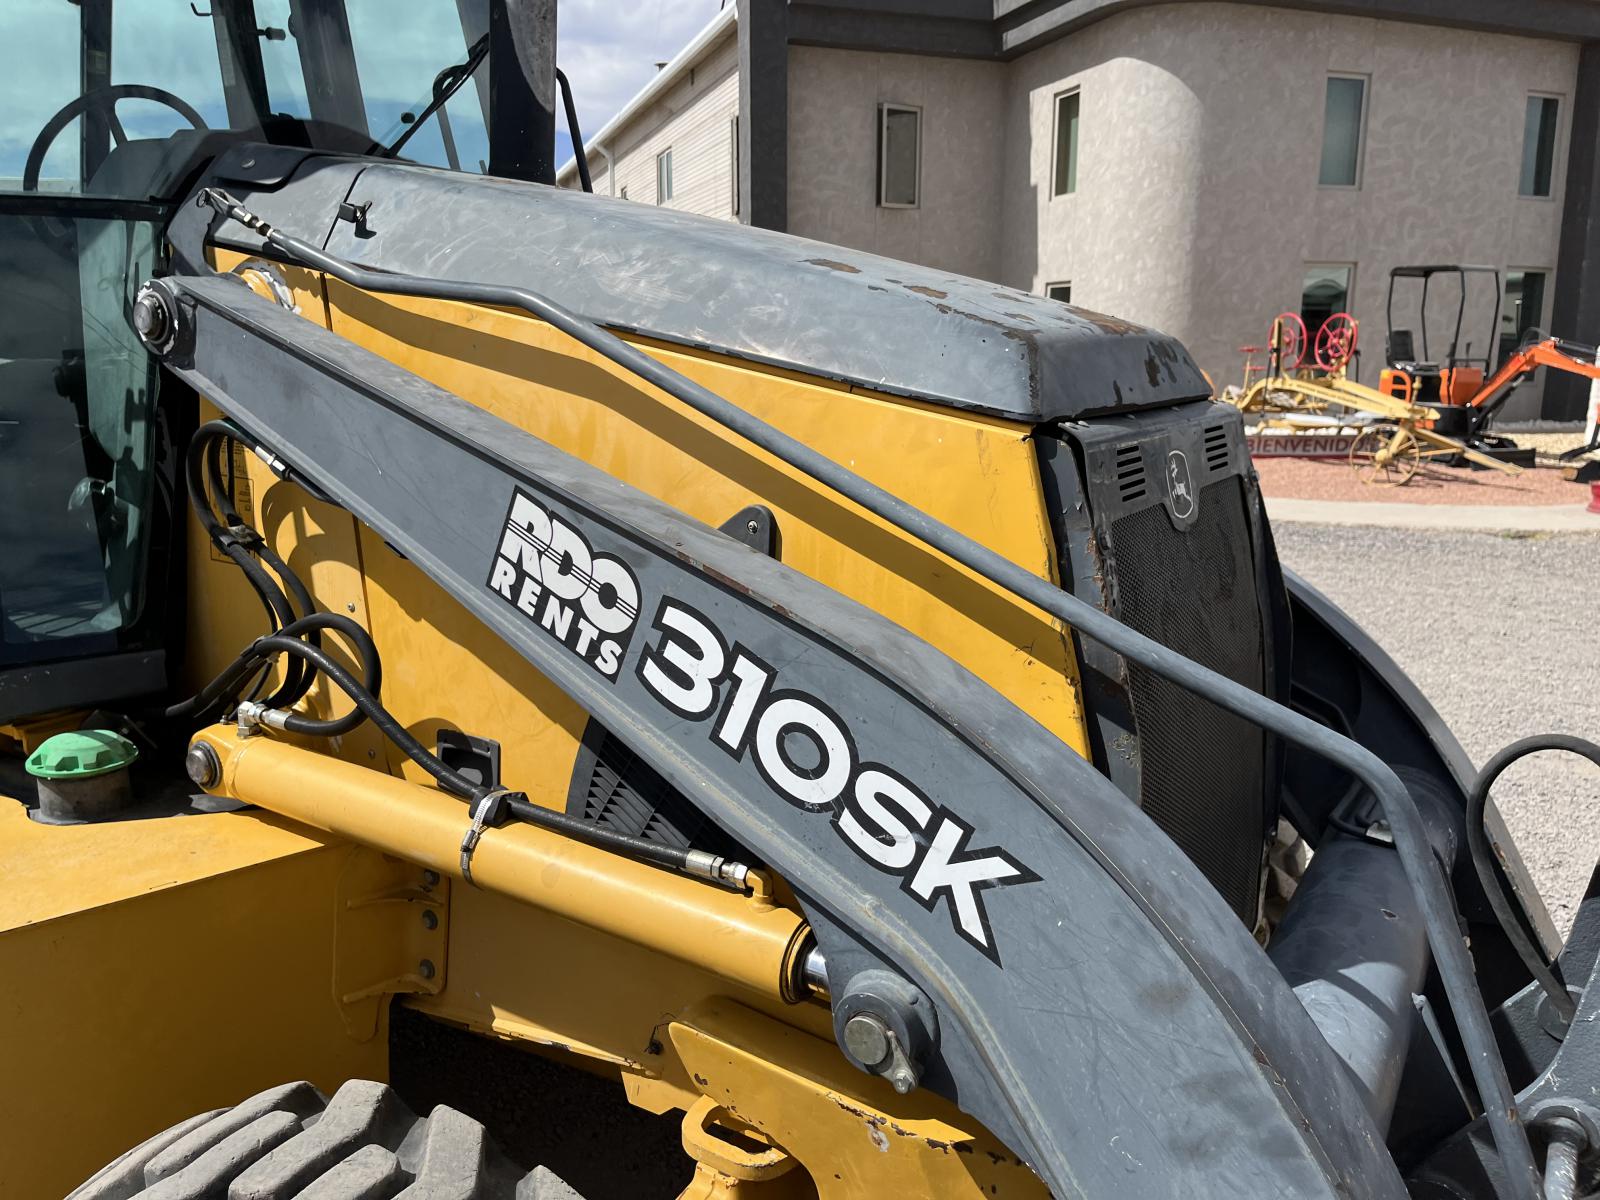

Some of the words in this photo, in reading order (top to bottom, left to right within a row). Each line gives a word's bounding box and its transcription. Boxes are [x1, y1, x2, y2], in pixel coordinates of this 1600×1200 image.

[490, 556, 624, 675] RENTS
[500, 493, 638, 634] RDO
[642, 605, 1021, 948] 310SK
